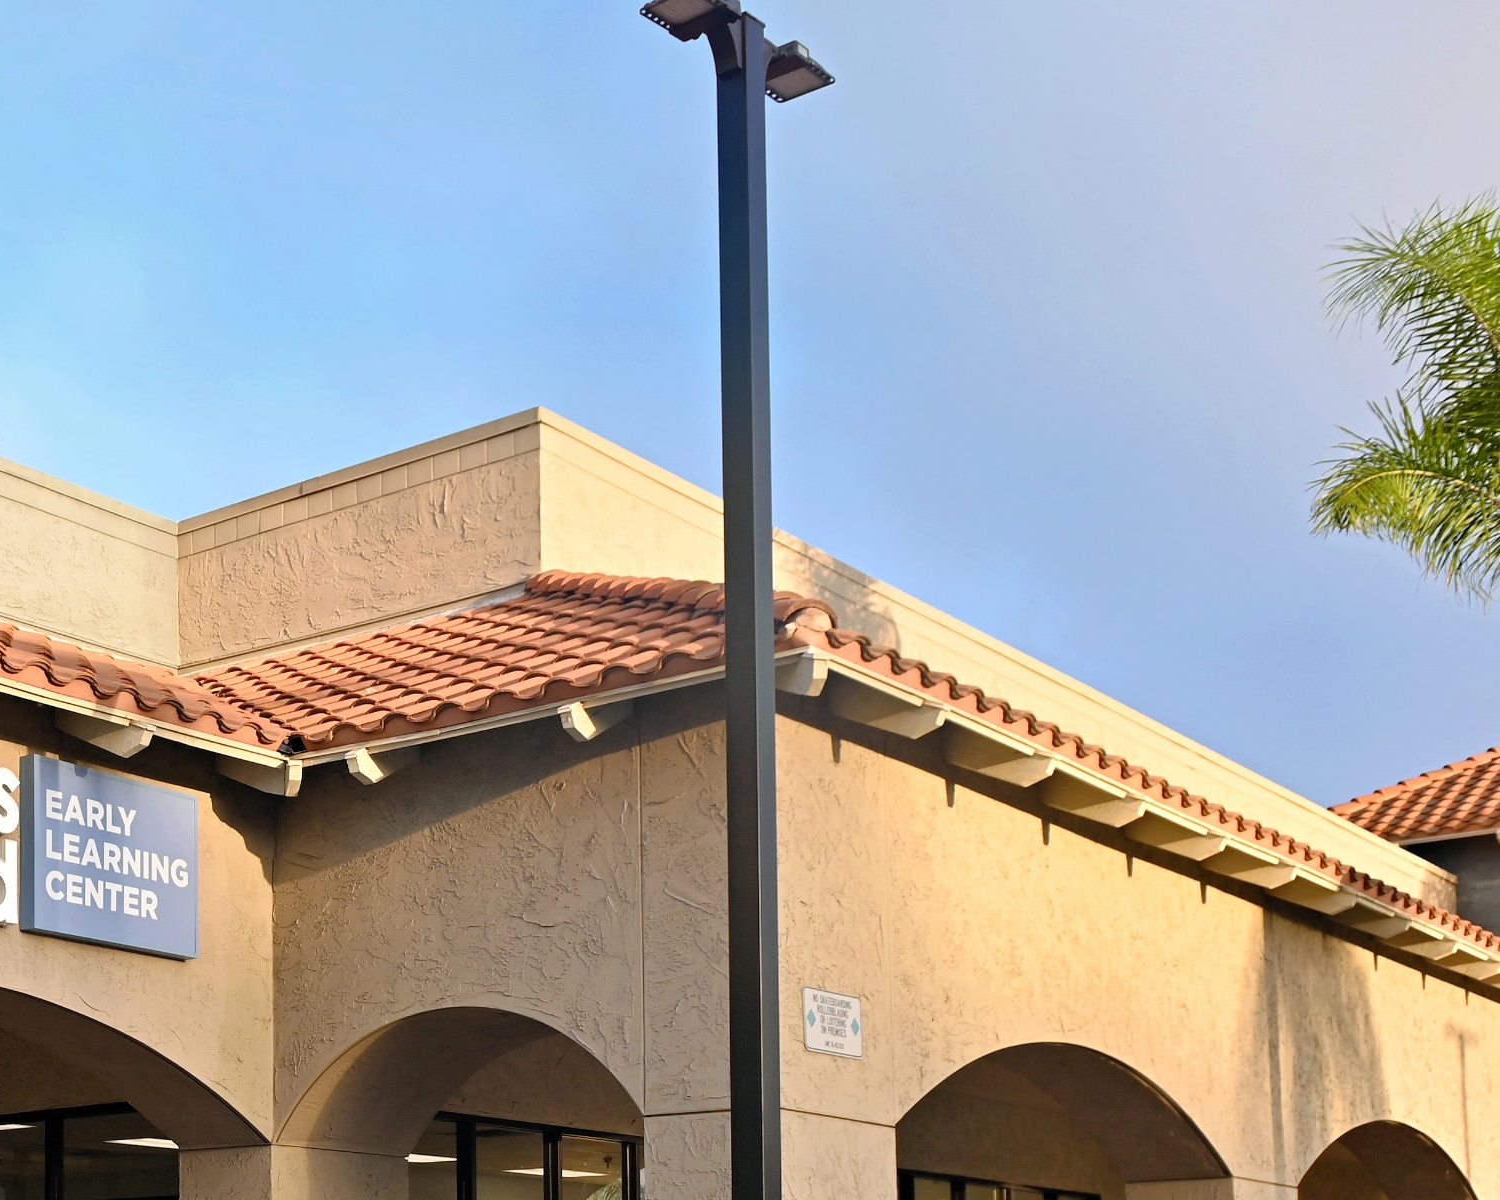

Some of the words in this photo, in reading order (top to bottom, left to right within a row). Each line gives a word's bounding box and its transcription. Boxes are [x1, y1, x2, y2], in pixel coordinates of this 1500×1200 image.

[45, 788, 137, 837] EARLY
[45, 828, 189, 888] LEARNING
[45, 870, 159, 920] CENTER
[812, 993, 819, 1003] NO
[819, 995, 852, 1010] SKATEBOARDING
